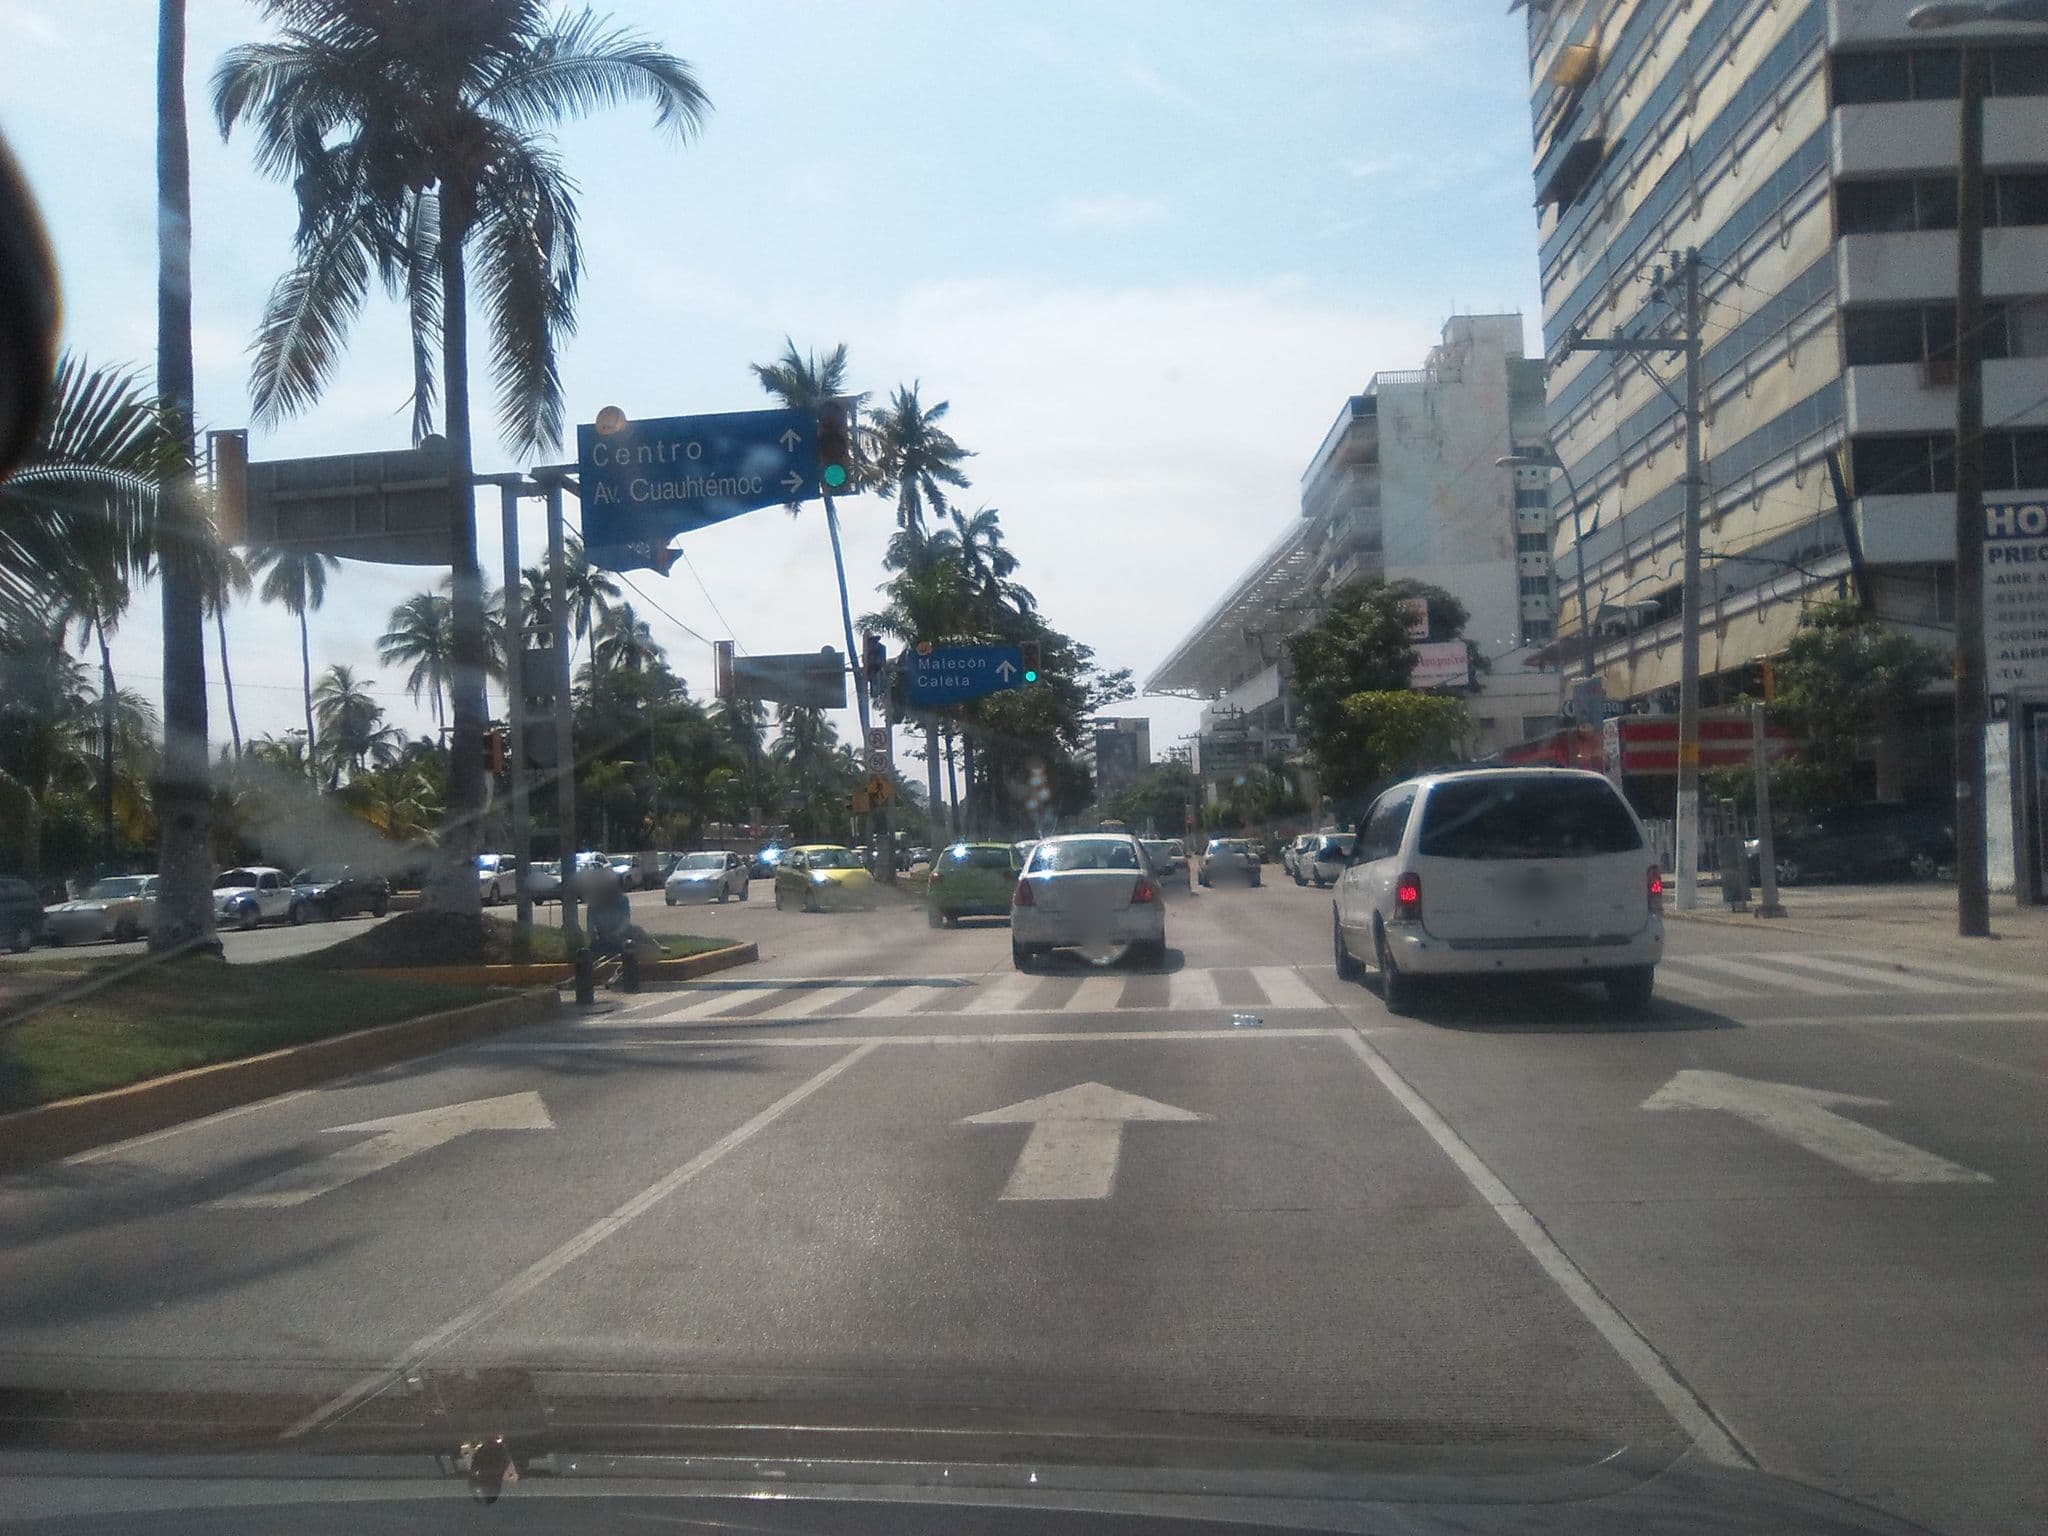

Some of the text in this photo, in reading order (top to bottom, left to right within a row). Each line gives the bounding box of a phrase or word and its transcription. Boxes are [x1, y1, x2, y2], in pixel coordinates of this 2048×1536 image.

[593, 440, 702, 466] Centro
[594, 471, 763, 505] Av. Cuauhtémoc
